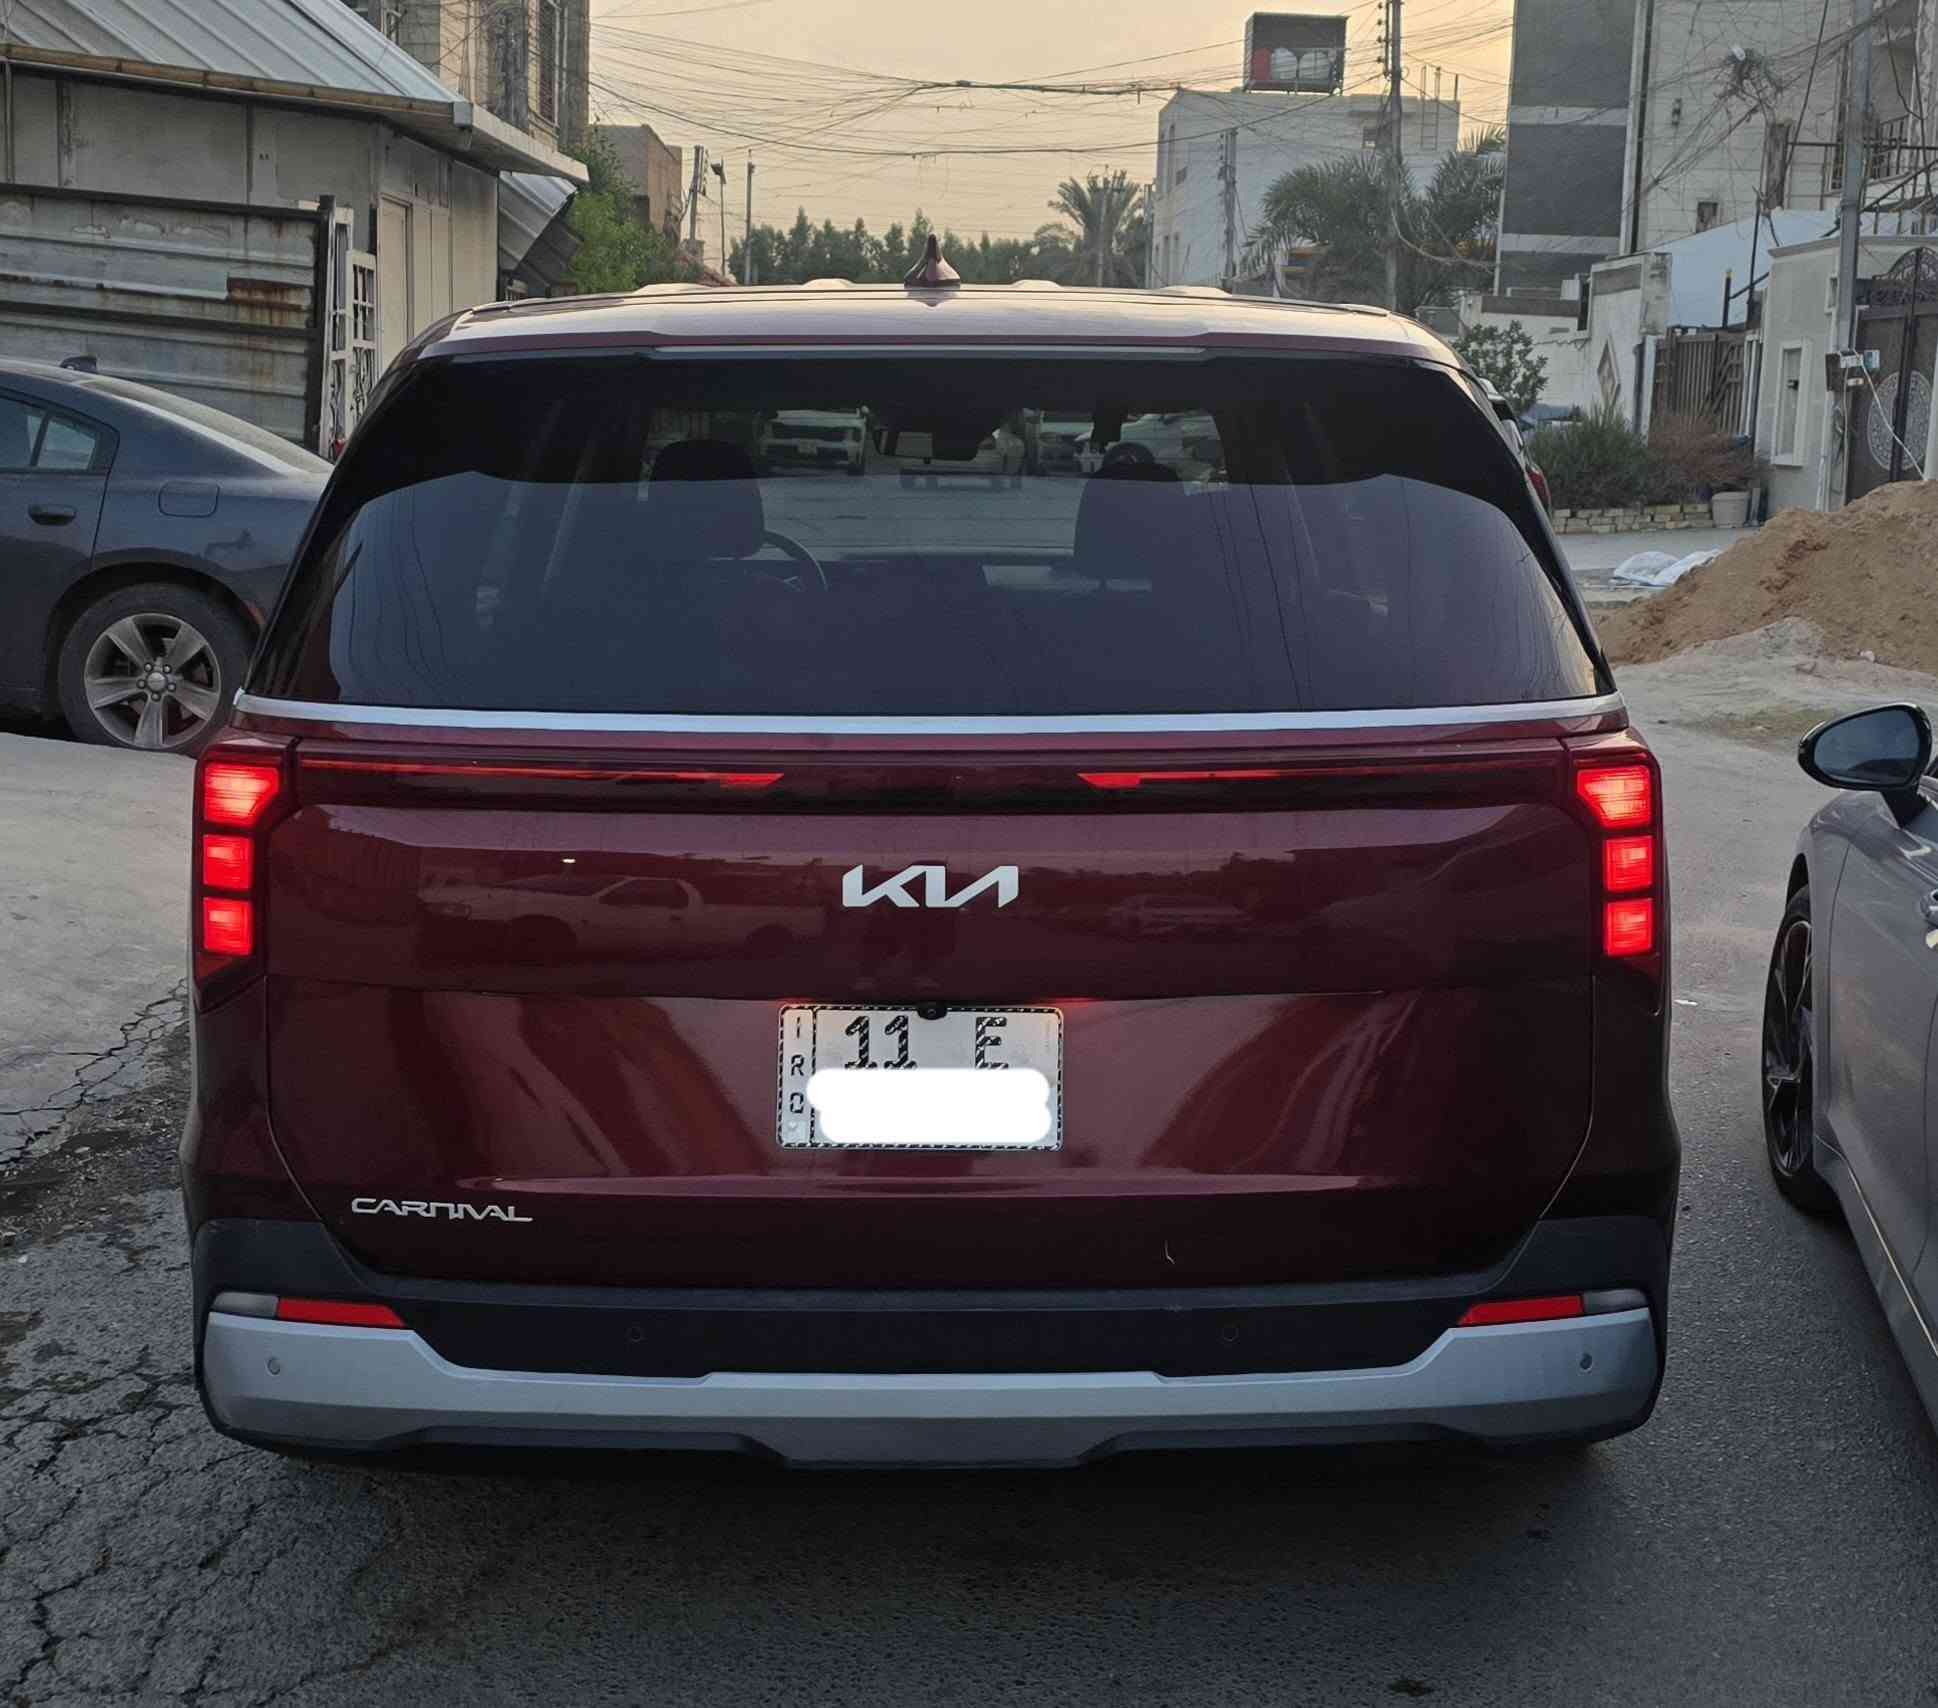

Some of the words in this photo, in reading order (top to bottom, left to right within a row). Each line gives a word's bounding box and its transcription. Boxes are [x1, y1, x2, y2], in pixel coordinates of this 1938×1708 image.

[842, 864, 1019, 908] KIA
[844, 1015, 917, 1070] 11
[974, 1015, 1009, 1070] E
[351, 1197, 534, 1222] CARNIVAL
